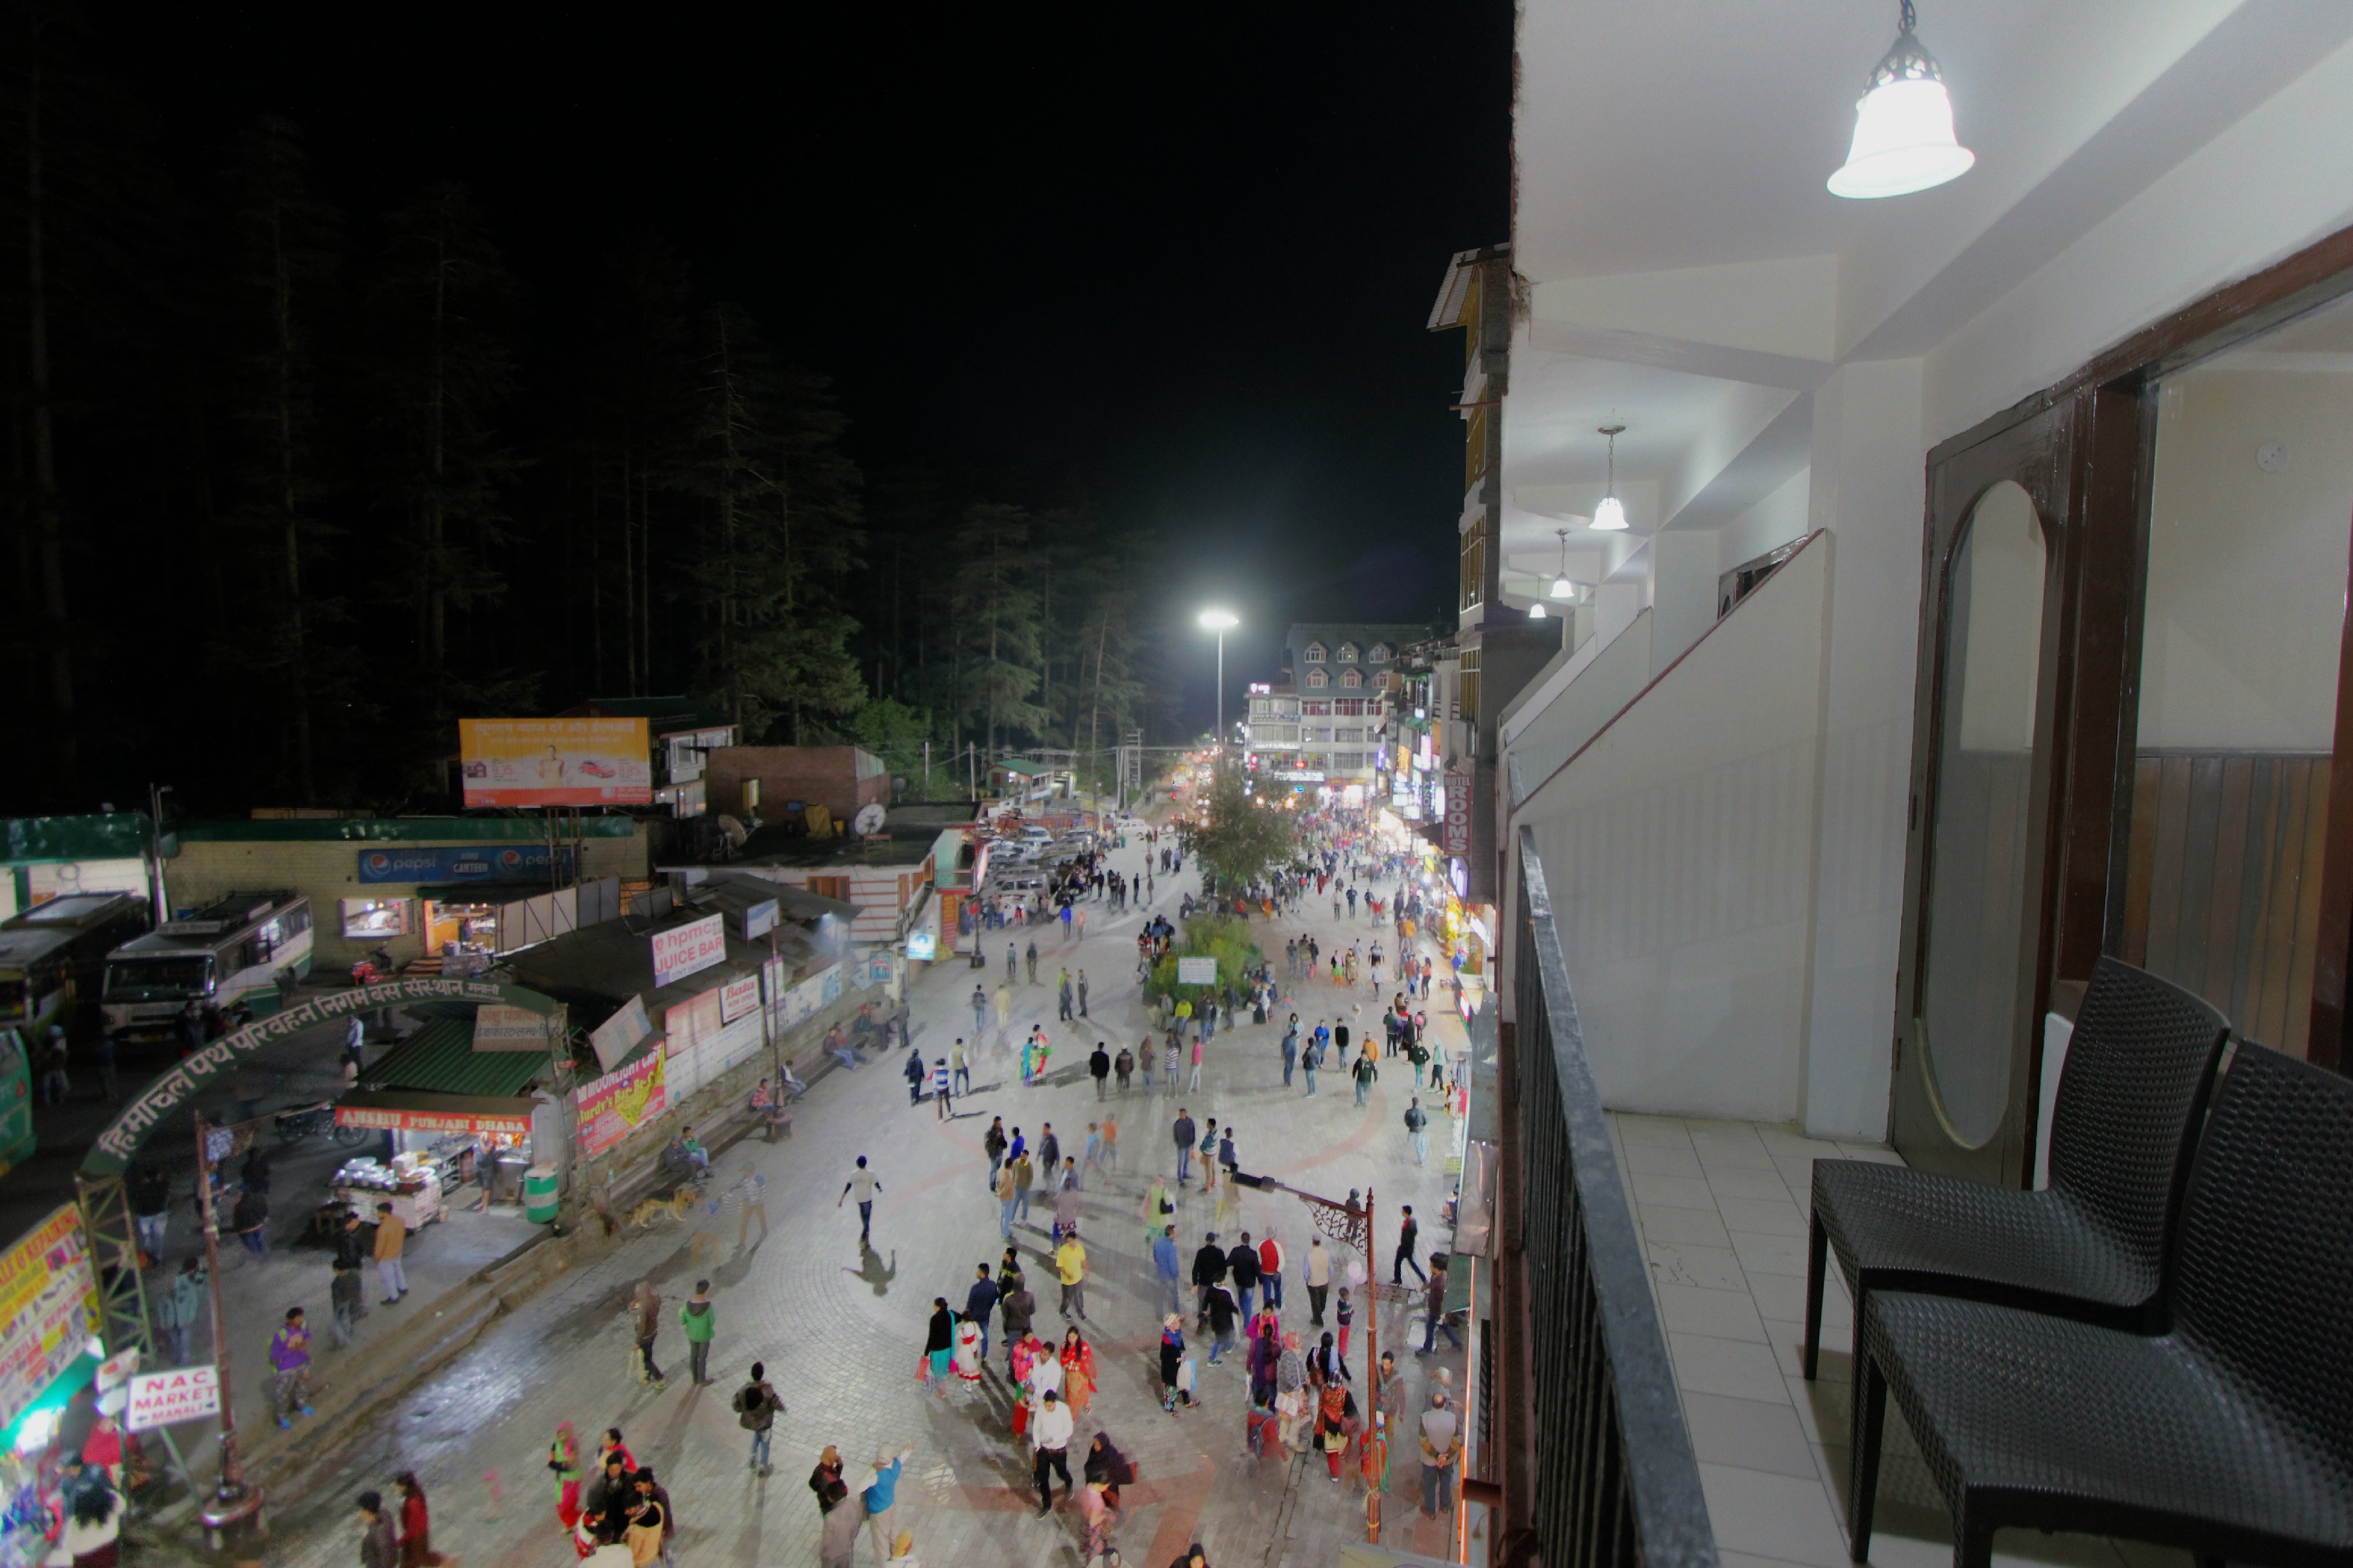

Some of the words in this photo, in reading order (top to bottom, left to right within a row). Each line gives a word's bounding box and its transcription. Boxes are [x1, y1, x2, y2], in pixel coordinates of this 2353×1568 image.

[1444, 777, 1470, 787] HOTEL
[1448, 786, 1467, 851] ROOMS
[393, 857, 436, 871] pepsi
[453, 862, 488, 873] CANTEEN
[667, 922, 711, 948] hpmc
[656, 946, 695, 973] JUICE
[699, 936, 723, 956] BAR
[726, 980, 755, 1001] Bata
[98, 1067, 196, 1160] हिमाचल
[184, 1041, 235, 1075] पथ
[224, 1003, 318, 1051] परिवहन
[313, 987, 370, 1018] निगम
[367, 982, 402, 1002] बस
[588, 1060, 639, 1099] MOONLIGHT
[341, 1110, 401, 1126] ANSHU
[409, 1117, 470, 1130] PUNJABI
[475, 1120, 526, 1132] DHABA
[146, 1370, 208, 1394] NAC
[134, 1384, 218, 1412] MARKET
[152, 1402, 203, 1421] MANALI
